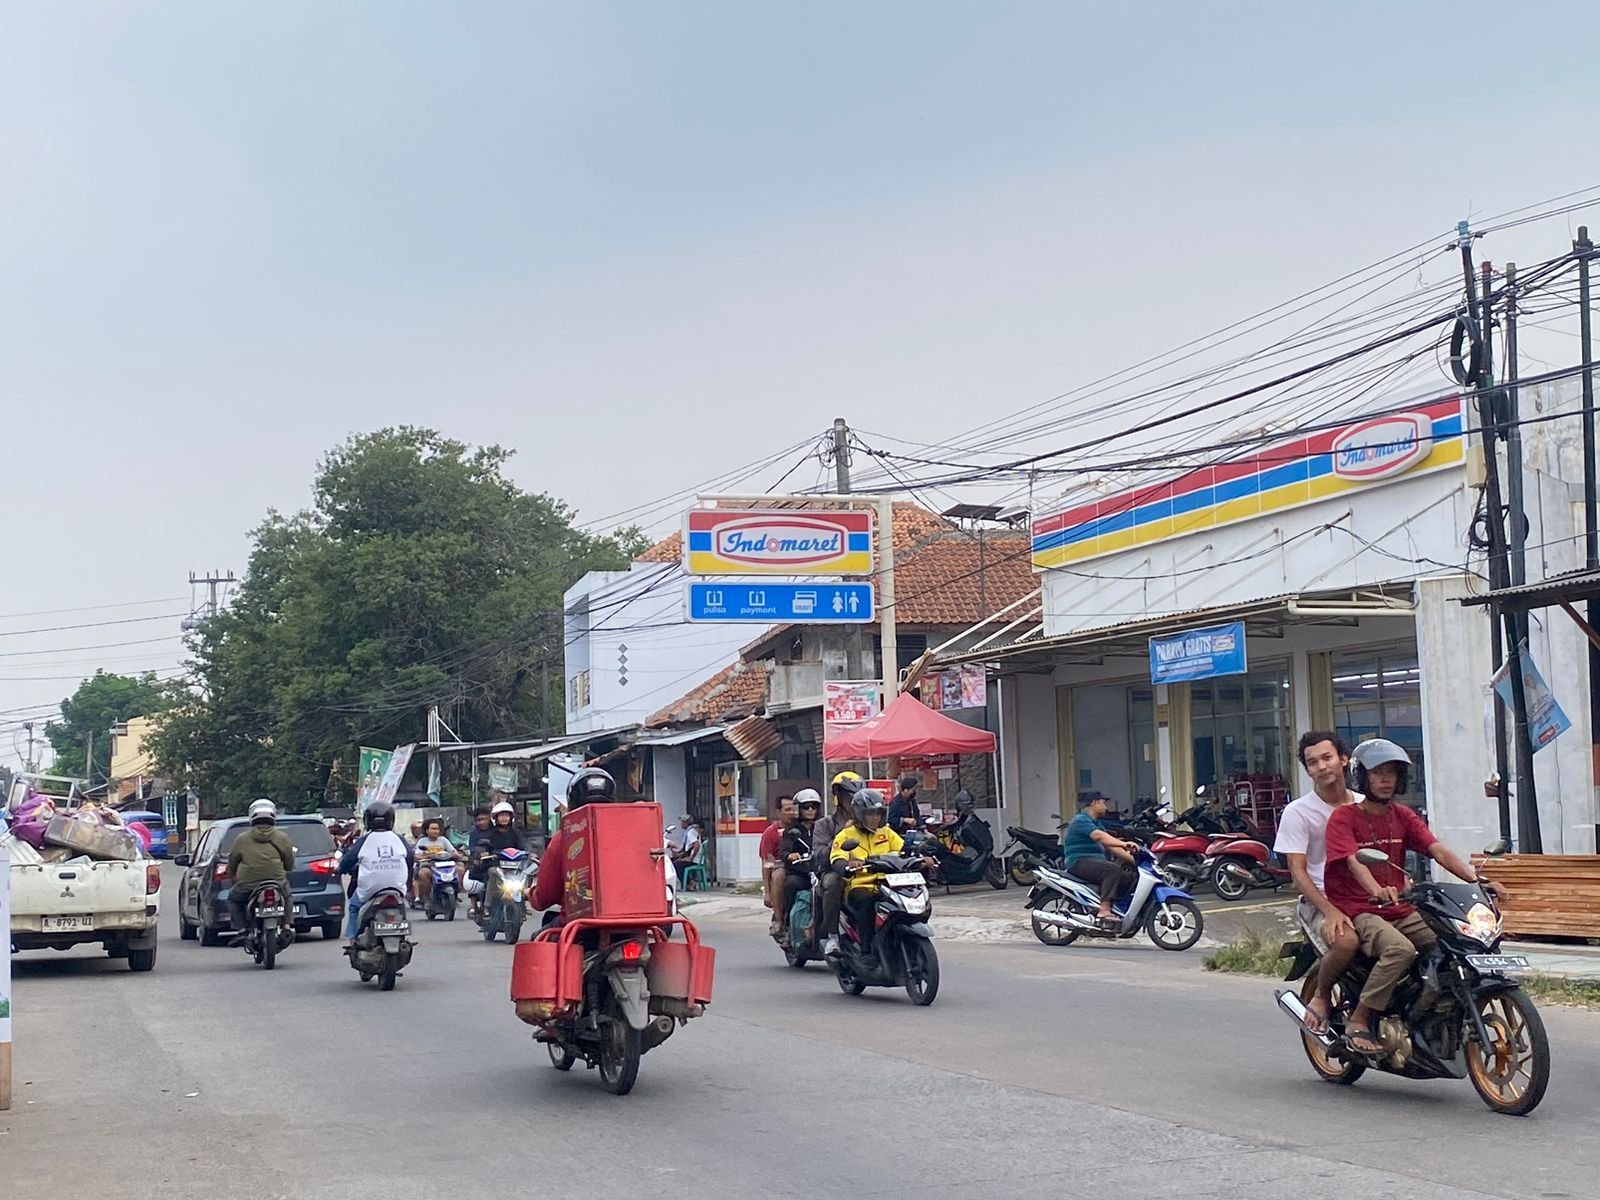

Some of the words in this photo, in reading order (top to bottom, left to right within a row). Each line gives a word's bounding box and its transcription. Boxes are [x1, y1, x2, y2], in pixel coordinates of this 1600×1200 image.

[1340, 428, 1414, 467] Indomaret
[723, 532, 839, 553] Indomaret
[703, 605, 727, 615] pulsa
[740, 606, 777, 615] payment
[43, 919, 50, 928] A
[56, 918, 78, 927] 8791
